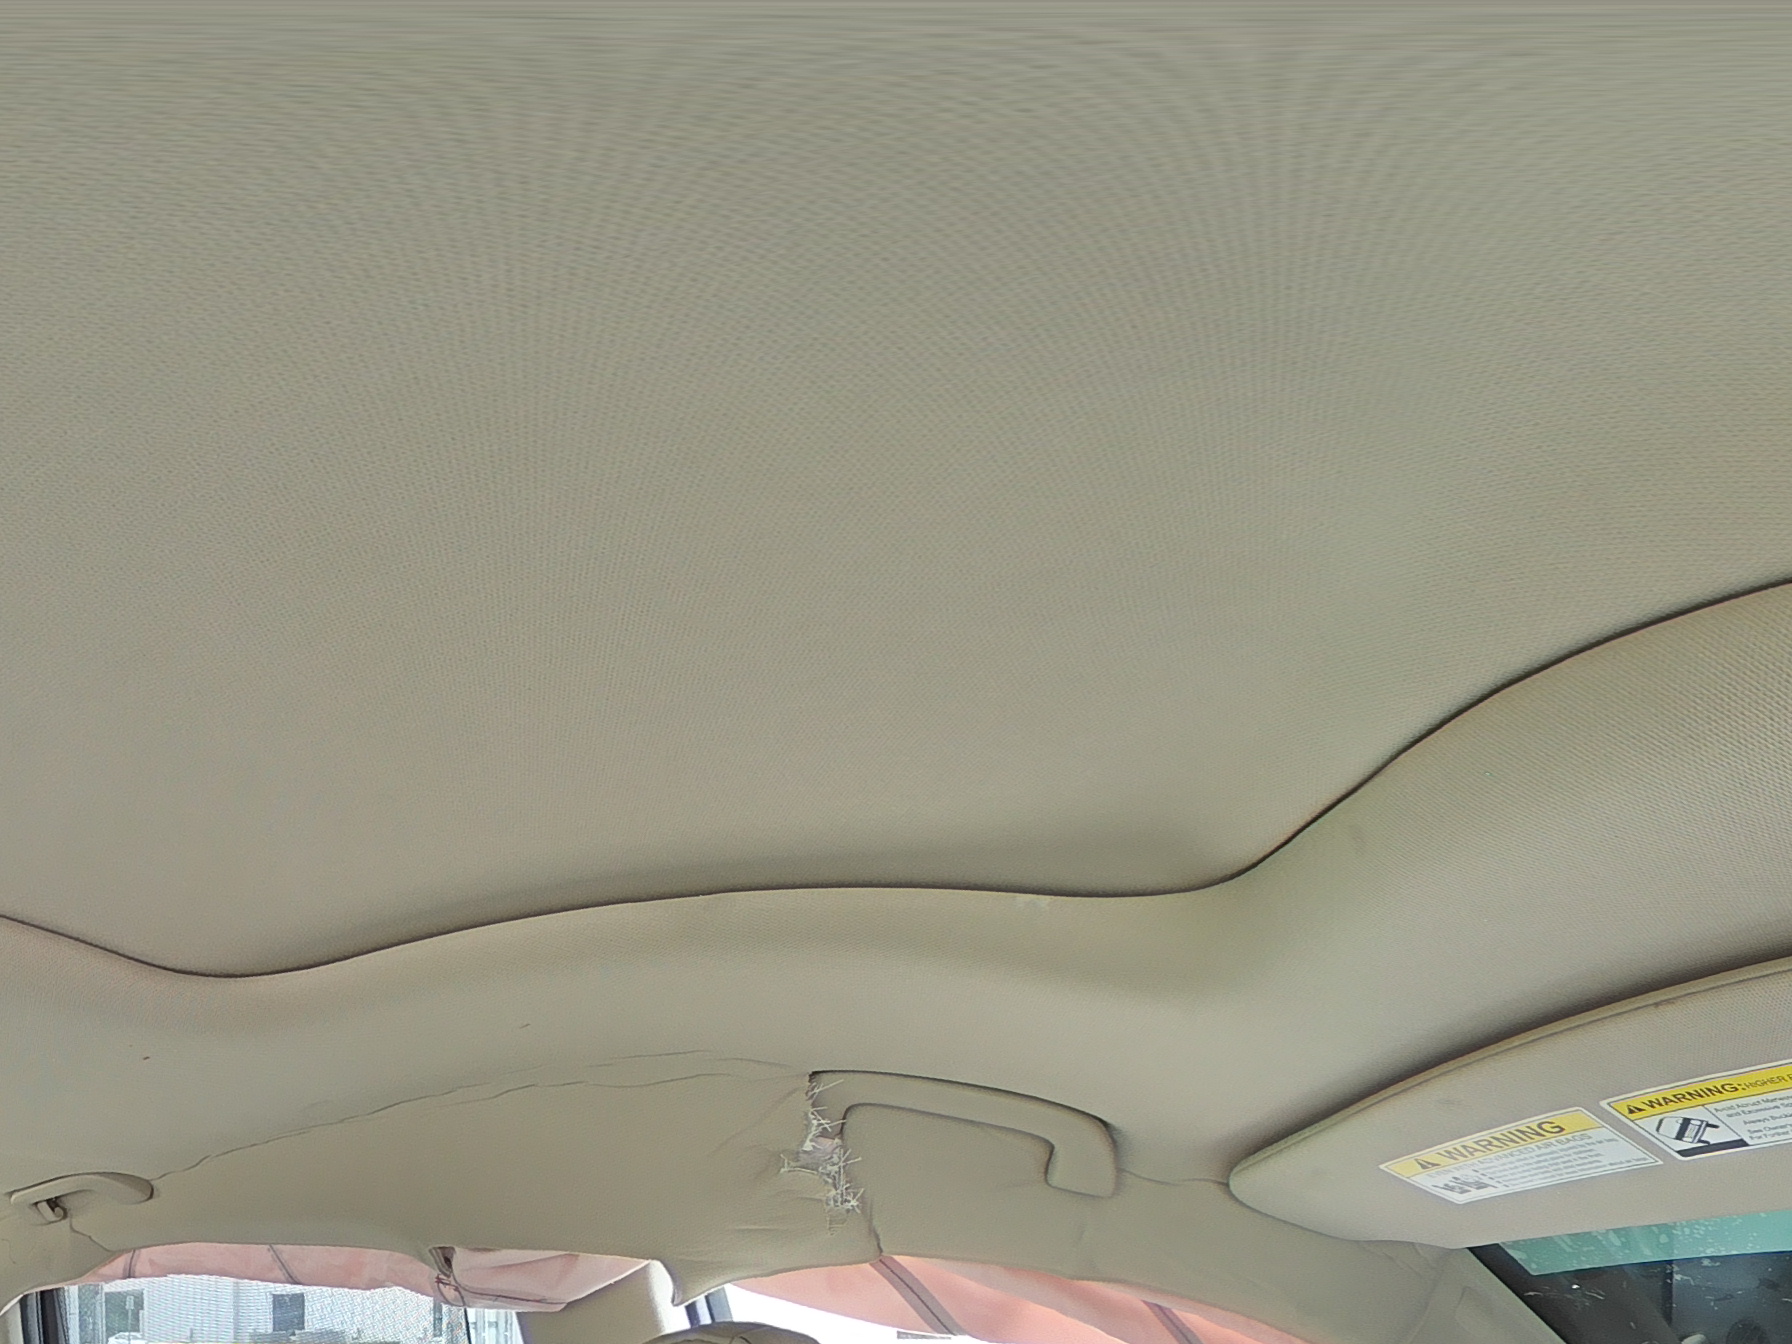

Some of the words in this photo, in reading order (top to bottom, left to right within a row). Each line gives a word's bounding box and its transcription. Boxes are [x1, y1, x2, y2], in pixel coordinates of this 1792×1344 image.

[1643, 1082, 1746, 1110] WARNING:
[1745, 1074, 1787, 1090] HIGHER
[1713, 1103, 1736, 1113] Avoid
[1726, 1109, 1742, 1118] and
[1742, 1105, 1781, 1116] Excessive
[1743, 1116, 1770, 1126] Always
[1435, 1120, 1566, 1162] WARNING
[1749, 1133, 1764, 1141] For
[1764, 1128, 1790, 1139] Further
[1536, 1140, 1557, 1152] AIR
[1557, 1133, 1593, 1146] BAGS
